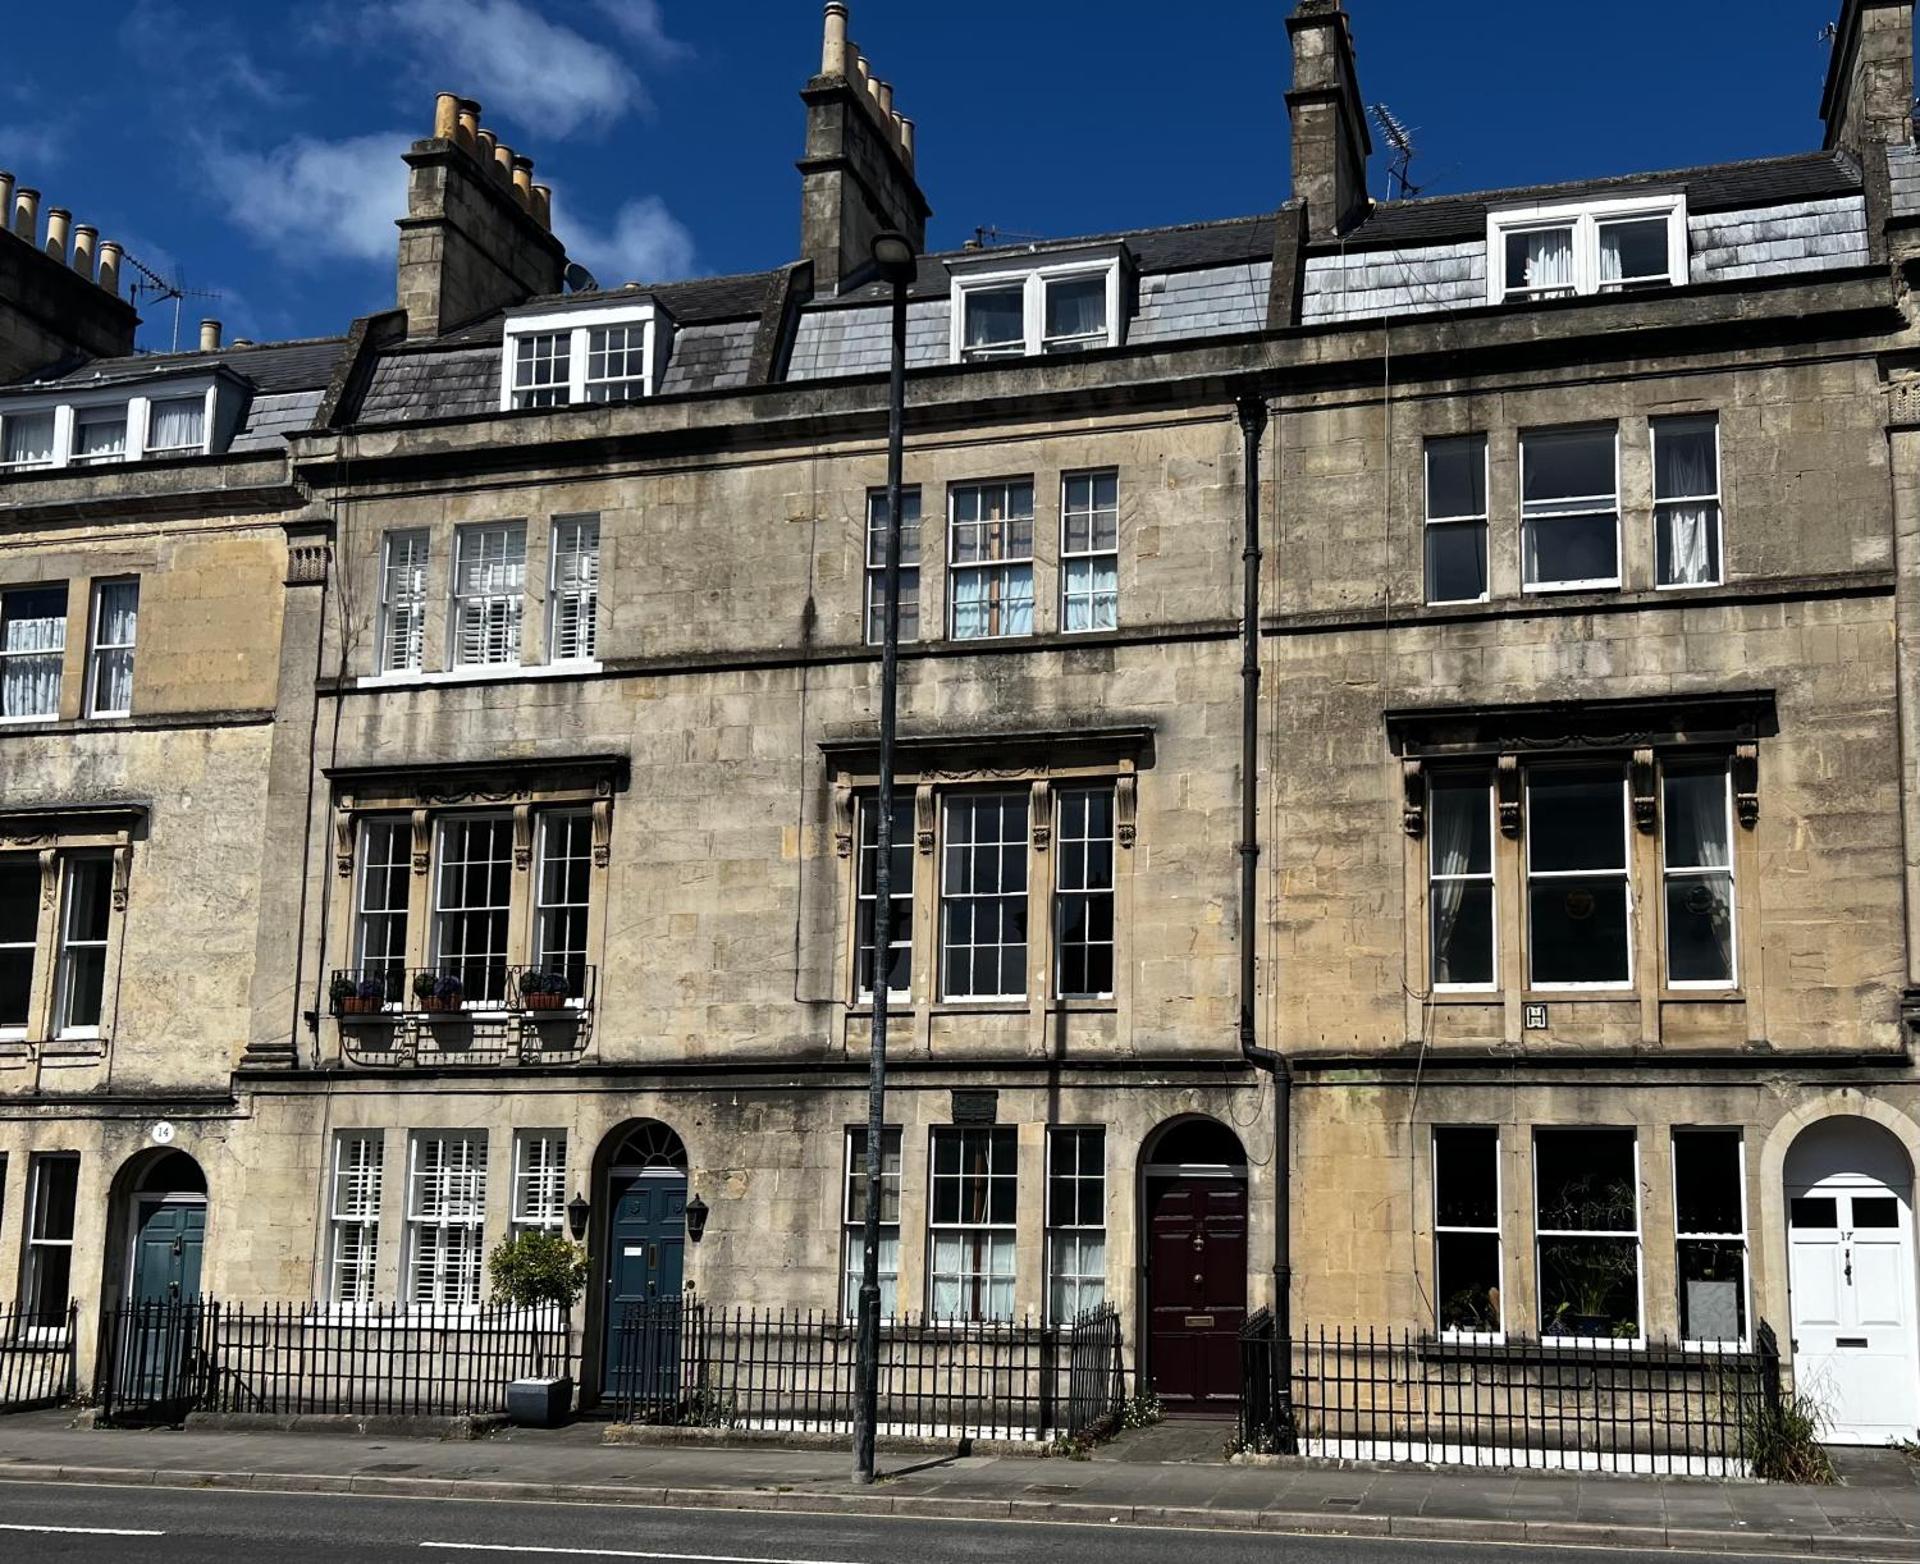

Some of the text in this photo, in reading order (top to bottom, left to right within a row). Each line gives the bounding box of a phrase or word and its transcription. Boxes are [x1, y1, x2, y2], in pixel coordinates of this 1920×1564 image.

[1529, 1008, 1543, 1025] H
[158, 1127, 169, 1137] 14
[1841, 1231, 1854, 1241] 17
